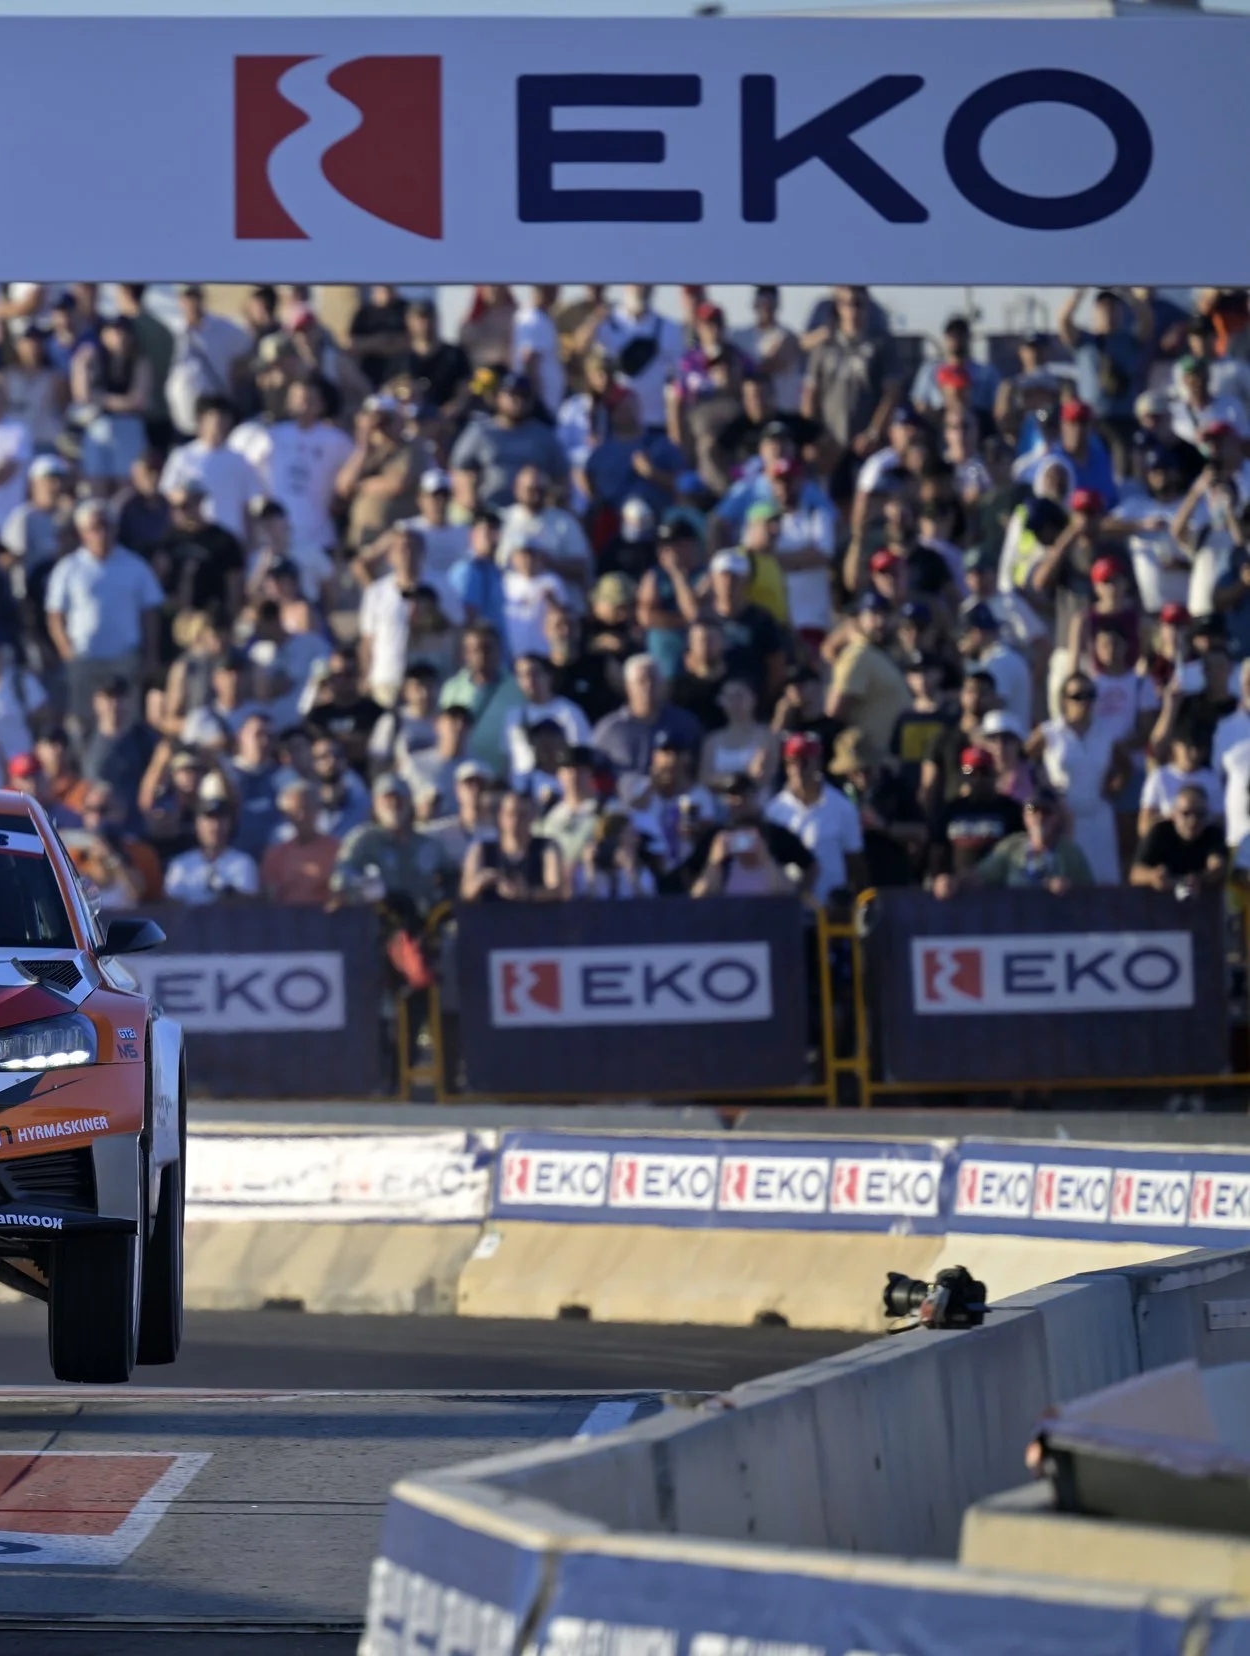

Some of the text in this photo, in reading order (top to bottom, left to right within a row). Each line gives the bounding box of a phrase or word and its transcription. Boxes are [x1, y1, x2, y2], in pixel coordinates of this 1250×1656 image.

[516, 68, 1154, 231] EKO
[582, 957, 759, 1008] EKO
[1003, 948, 1181, 996] EKO
[153, 967, 331, 1013] EKO
[18, 1115, 110, 1143] HYRMASKINER
[535, 1163, 605, 1196] EKO
[644, 1165, 713, 1199] EKO
[755, 1168, 825, 1202] EKO
[865, 1172, 935, 1205] EKO
[980, 1173, 1031, 1206] EKO
[1058, 1176, 1108, 1211] EKO
[1136, 1181, 1186, 1215] EKO
[1214, 1184, 1250, 1217] EK
